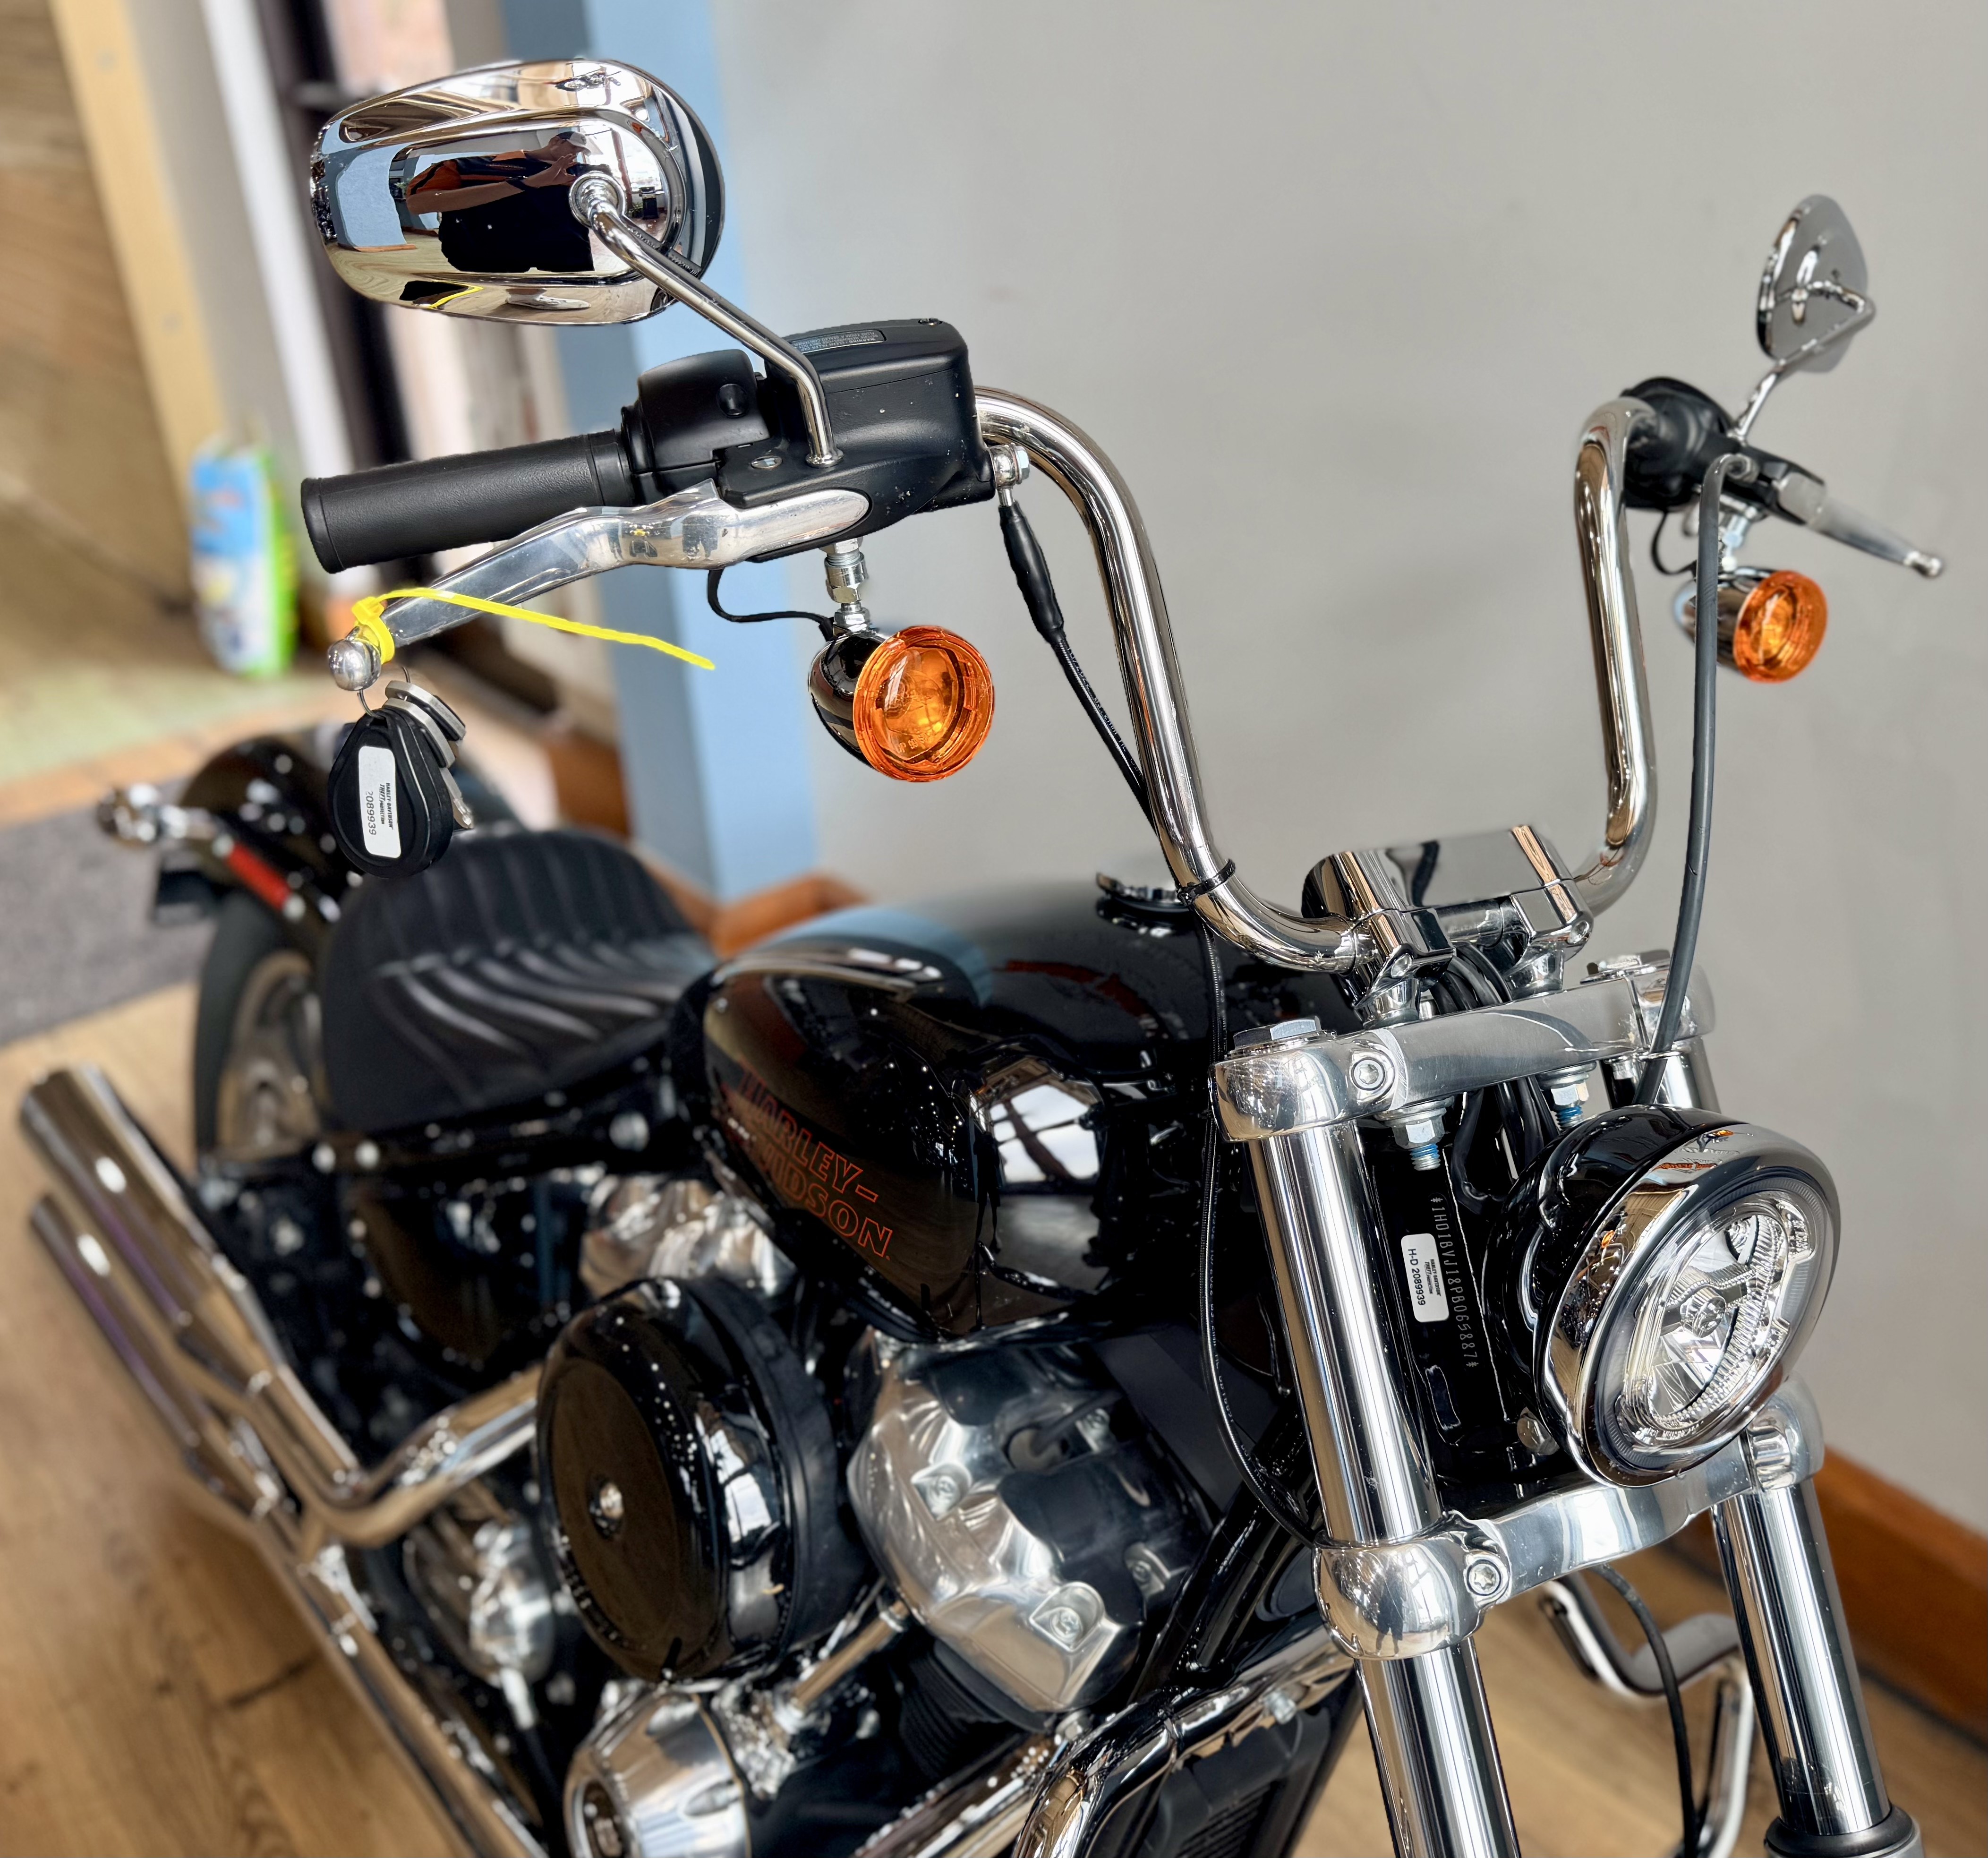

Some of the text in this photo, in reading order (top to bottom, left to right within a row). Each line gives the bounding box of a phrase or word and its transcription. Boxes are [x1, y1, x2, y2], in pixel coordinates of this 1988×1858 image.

[366, 790, 376, 835] 2089939
[1408, 1249, 1425, 1305] H-D 2089939
